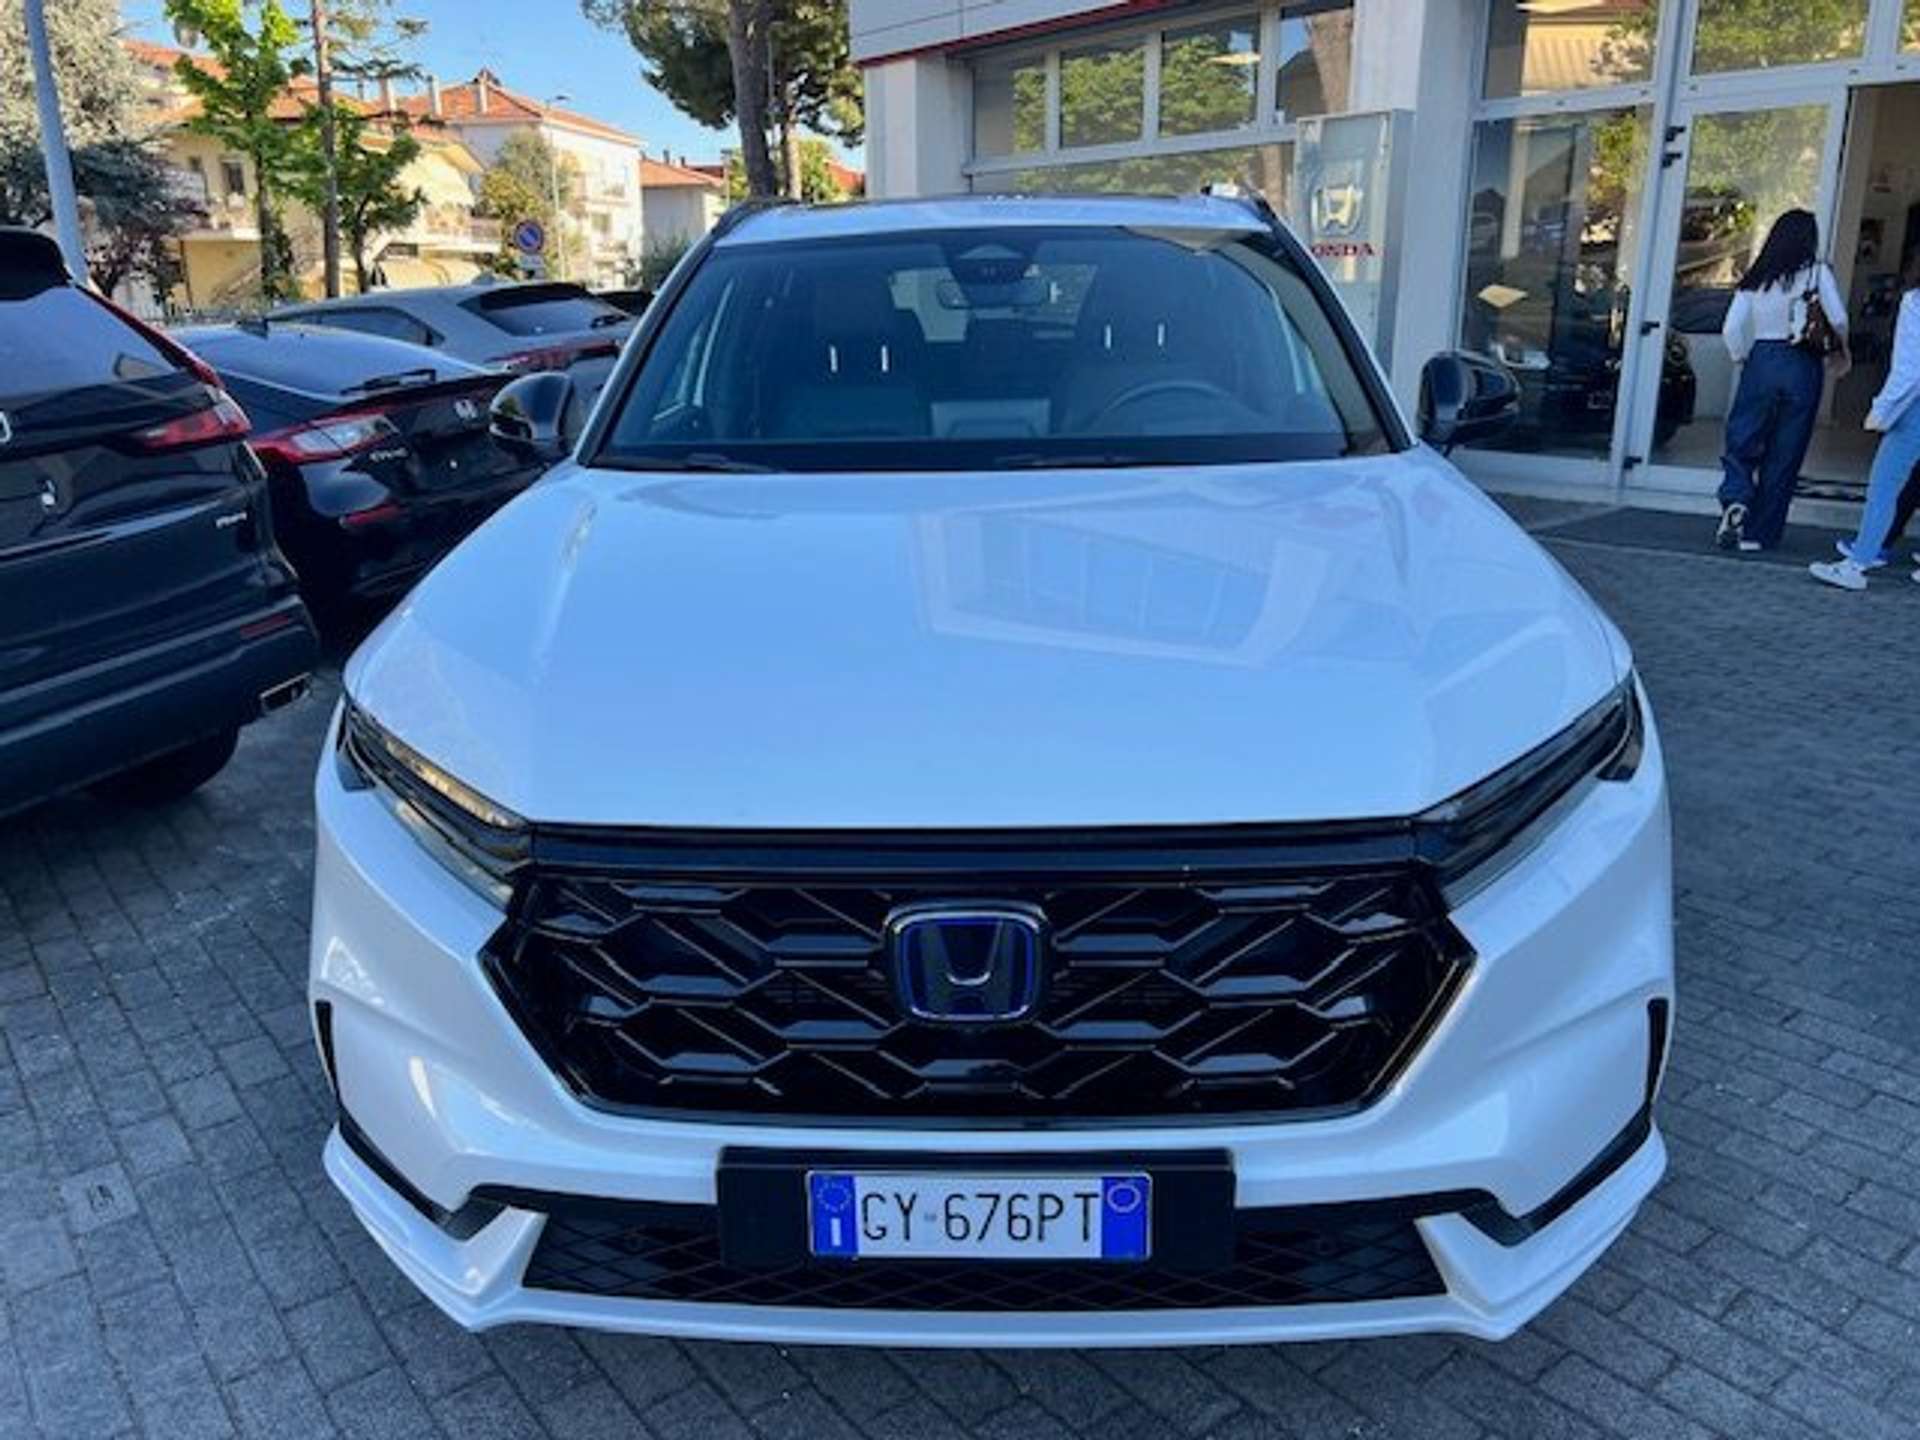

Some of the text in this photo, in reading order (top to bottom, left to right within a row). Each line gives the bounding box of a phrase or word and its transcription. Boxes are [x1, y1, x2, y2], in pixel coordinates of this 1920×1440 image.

[1308, 242, 1375, 258] ONDA
[861, 1192, 1100, 1242] GY 676PT
